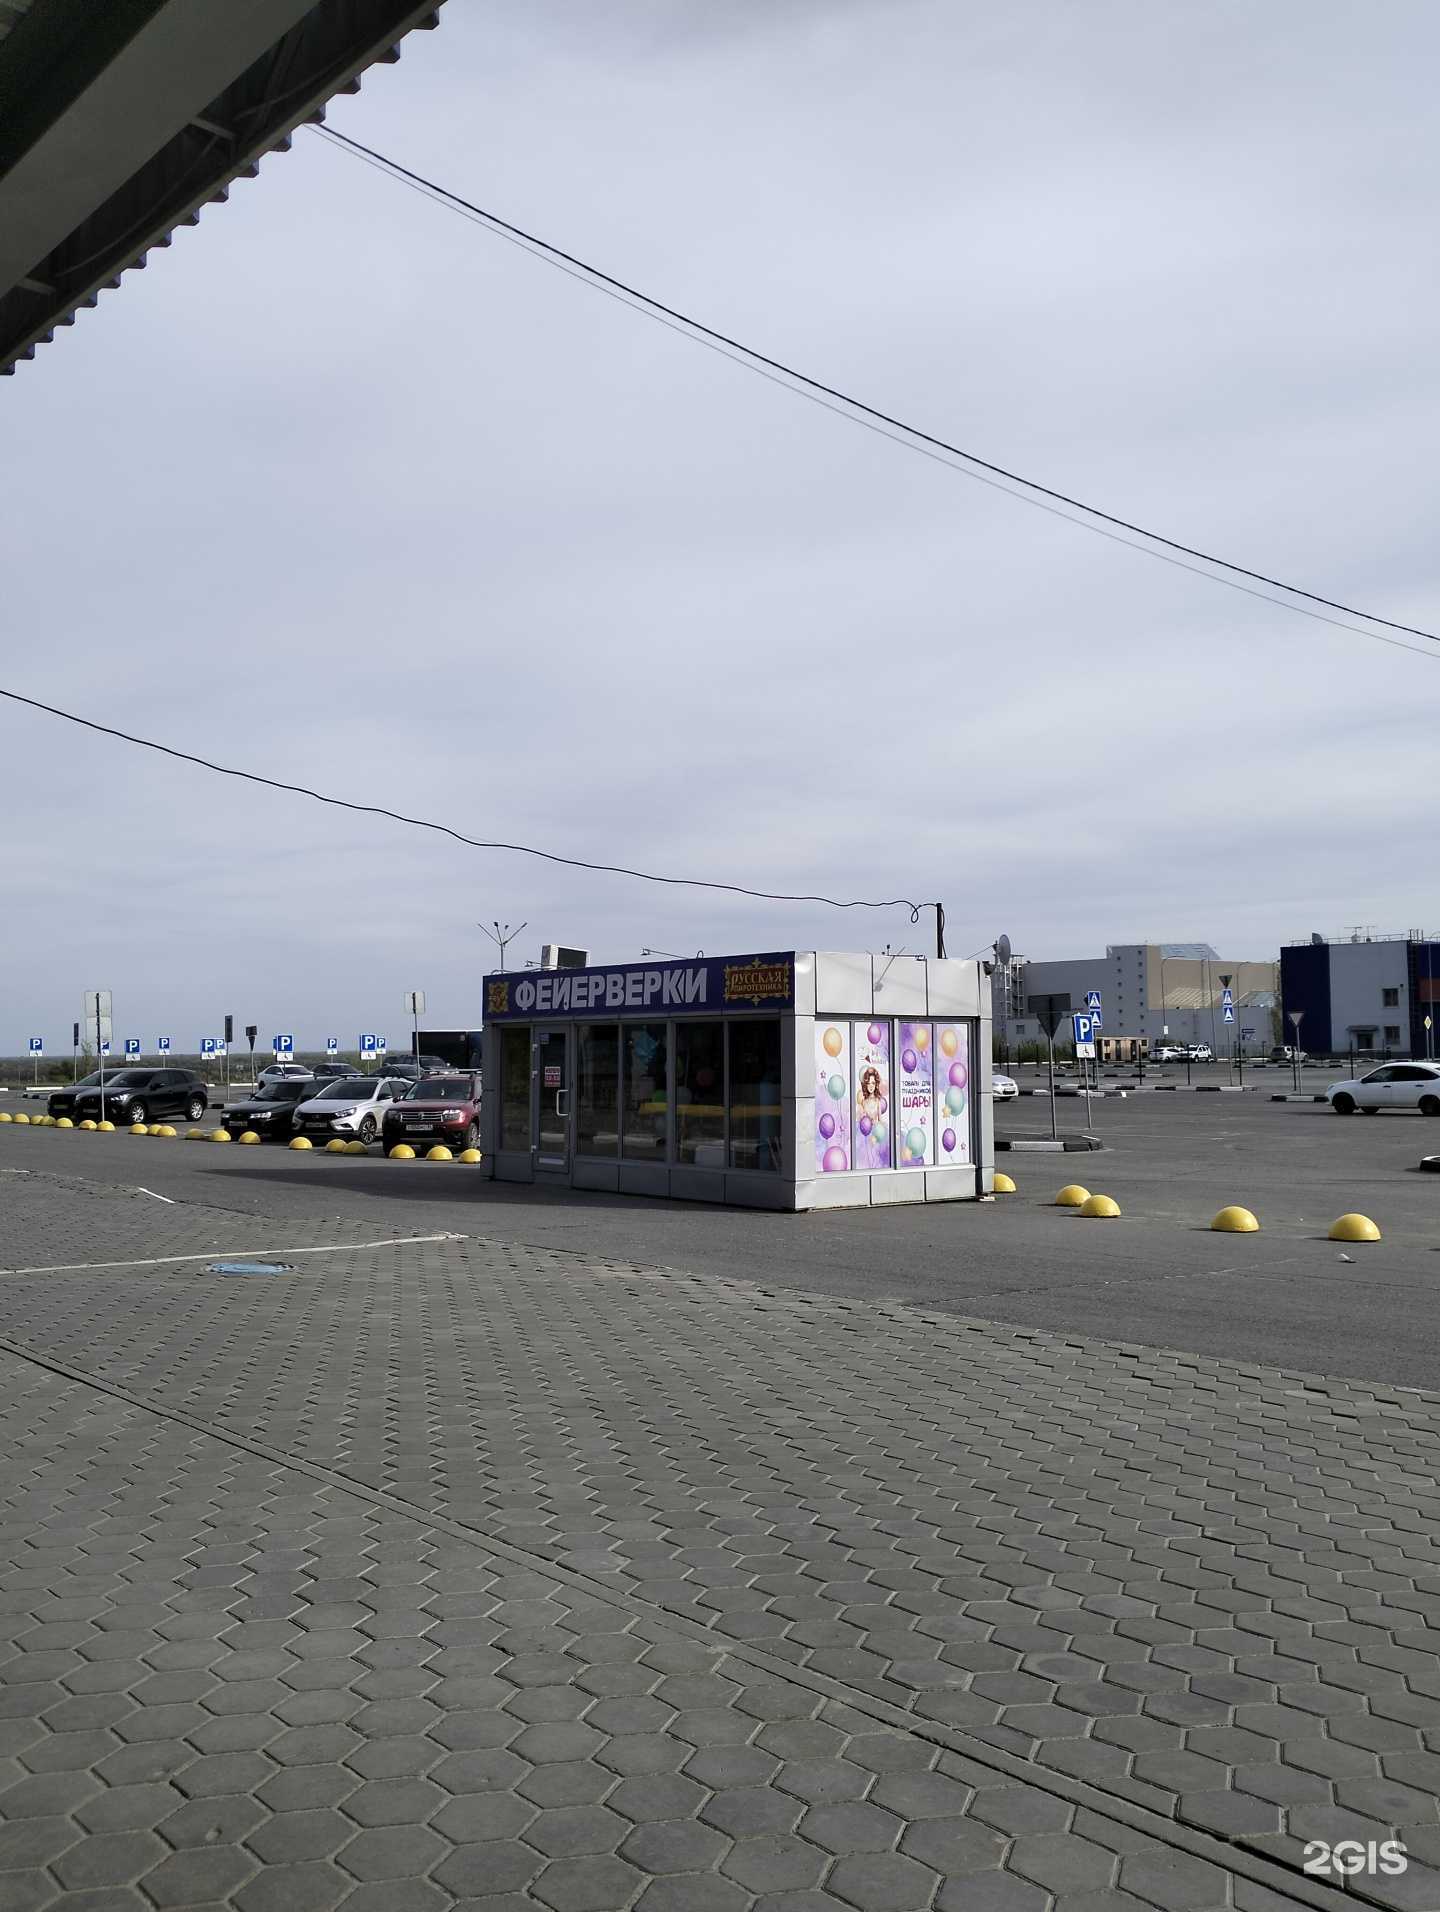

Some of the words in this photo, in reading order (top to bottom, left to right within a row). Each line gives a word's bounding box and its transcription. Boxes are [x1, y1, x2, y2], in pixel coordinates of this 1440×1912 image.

[515, 969, 707, 1010] ФЕЙЕРВЕРКИ
[1080, 1018, 1090, 1039] P
[902, 1096, 931, 1108] ШАРЫ
